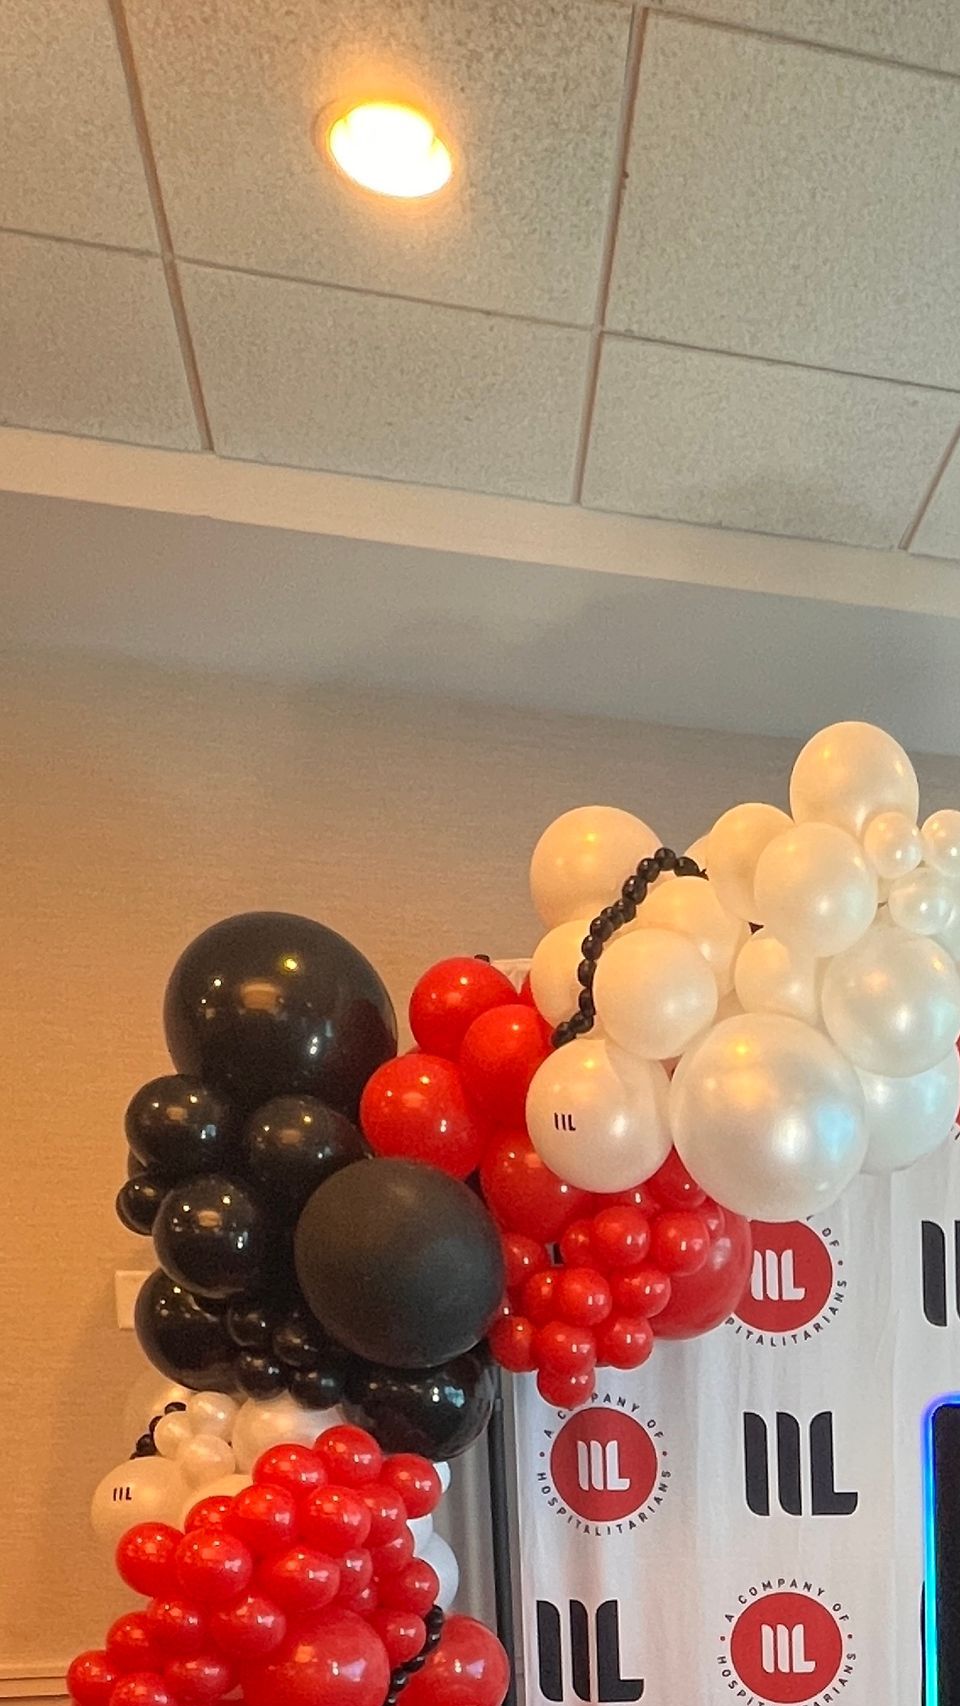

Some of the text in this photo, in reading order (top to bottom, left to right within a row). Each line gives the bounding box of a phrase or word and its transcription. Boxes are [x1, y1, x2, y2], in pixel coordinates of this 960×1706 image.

[725, 1227, 847, 1347] OF PITALITARIANS
[537, 1393, 671, 1536] A CPANY OF HOSPITALITARIANS
[725, 1614, 734, 1622] A
[738, 1579, 825, 1604] COMPANY
[832, 1603, 849, 1622] OF
